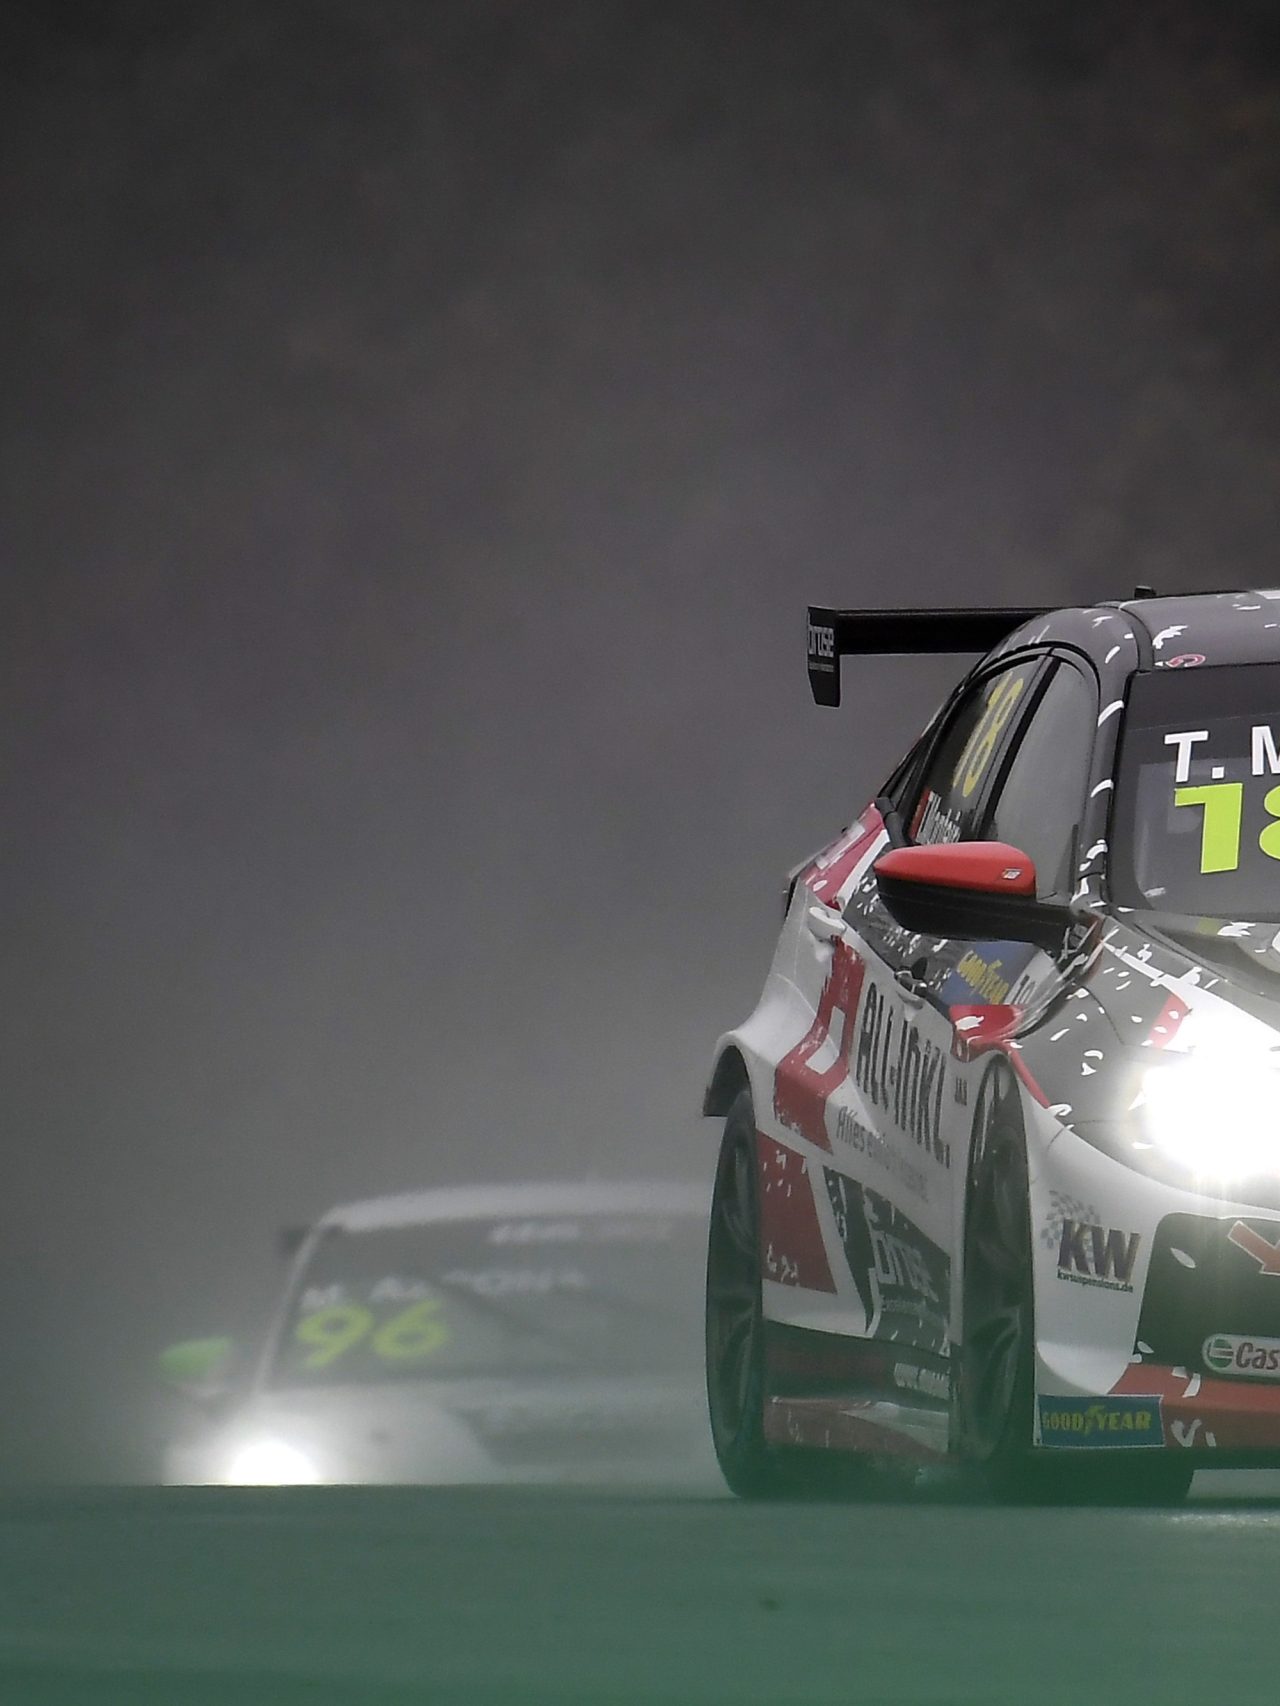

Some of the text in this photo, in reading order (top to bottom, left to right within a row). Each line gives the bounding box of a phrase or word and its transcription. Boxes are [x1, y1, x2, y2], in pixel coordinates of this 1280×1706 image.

[1164, 730, 1226, 783] T.
[1057, 1218, 1141, 1282] KW
[295, 1300, 450, 1369] 96
